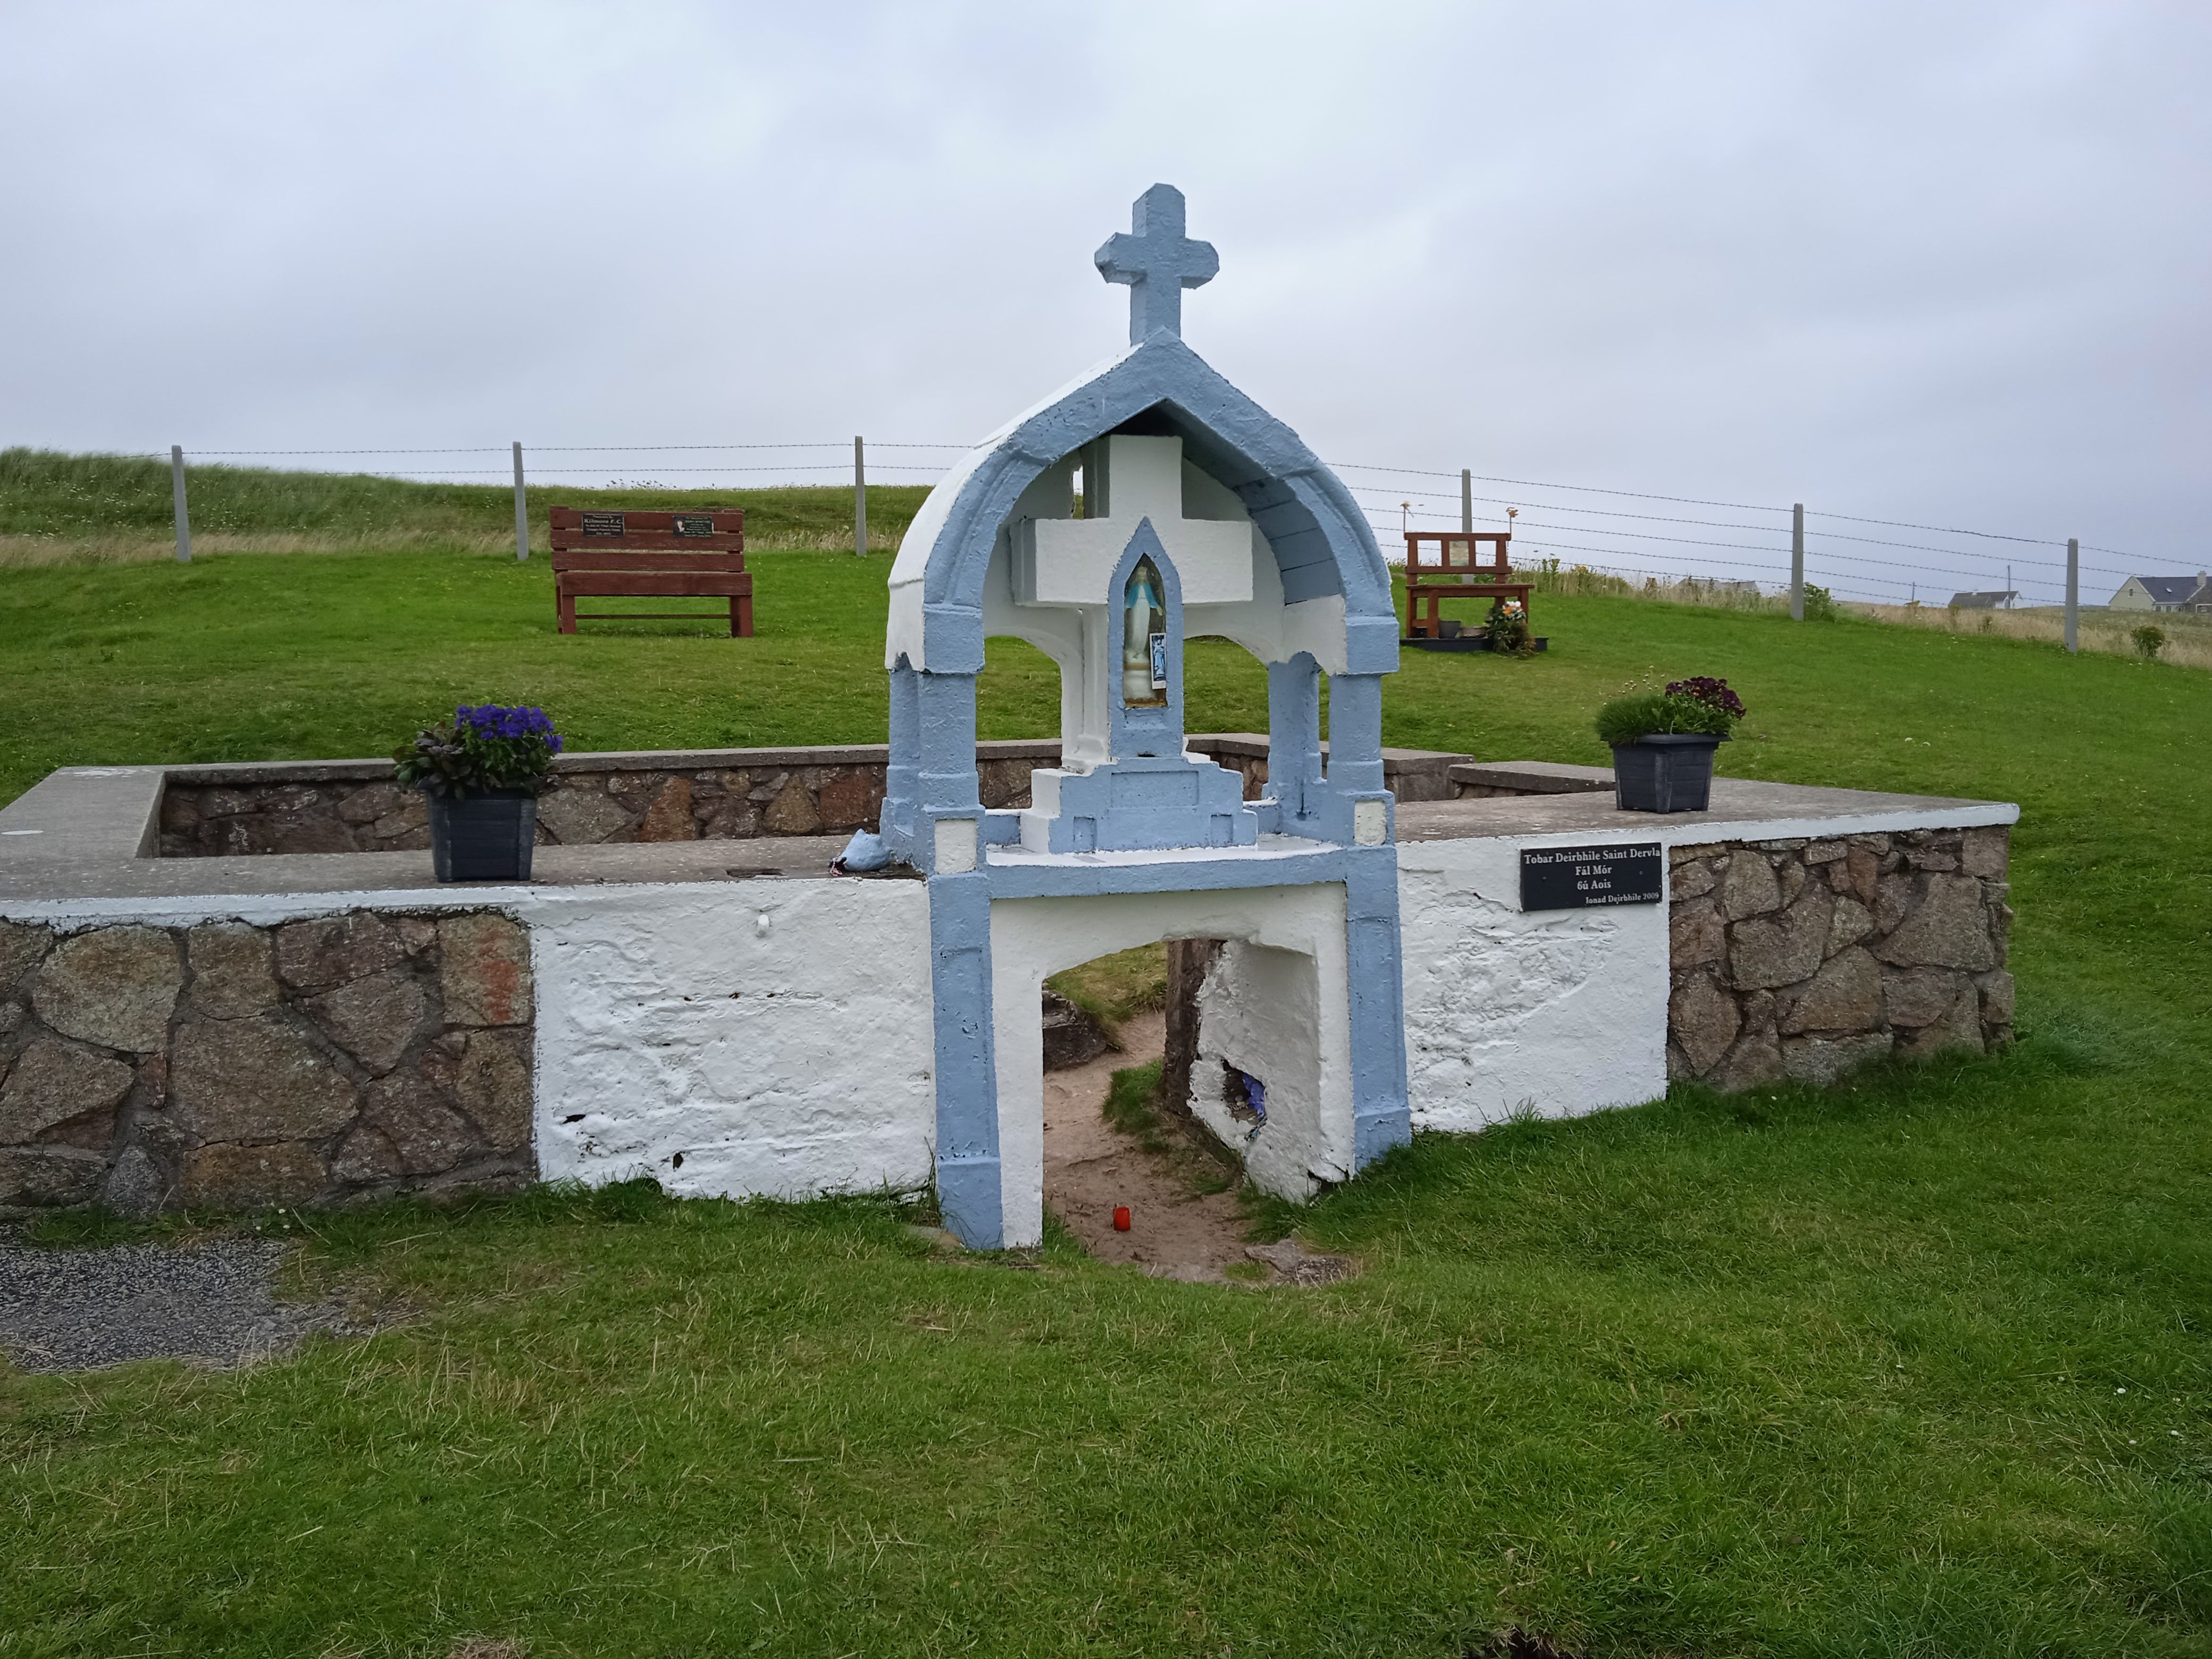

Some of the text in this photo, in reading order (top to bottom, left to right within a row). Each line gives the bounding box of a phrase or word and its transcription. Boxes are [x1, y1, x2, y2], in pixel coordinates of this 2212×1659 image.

[1524, 848, 1660, 864] Tobar Deirbhile Saint Dervla
[1575, 865, 1612, 876] Fál Mór
[1577, 879, 1611, 890] 6ú Aois
[1586, 894, 1606, 904] Ionad
[1608, 893, 1641, 903] Deirbhile
